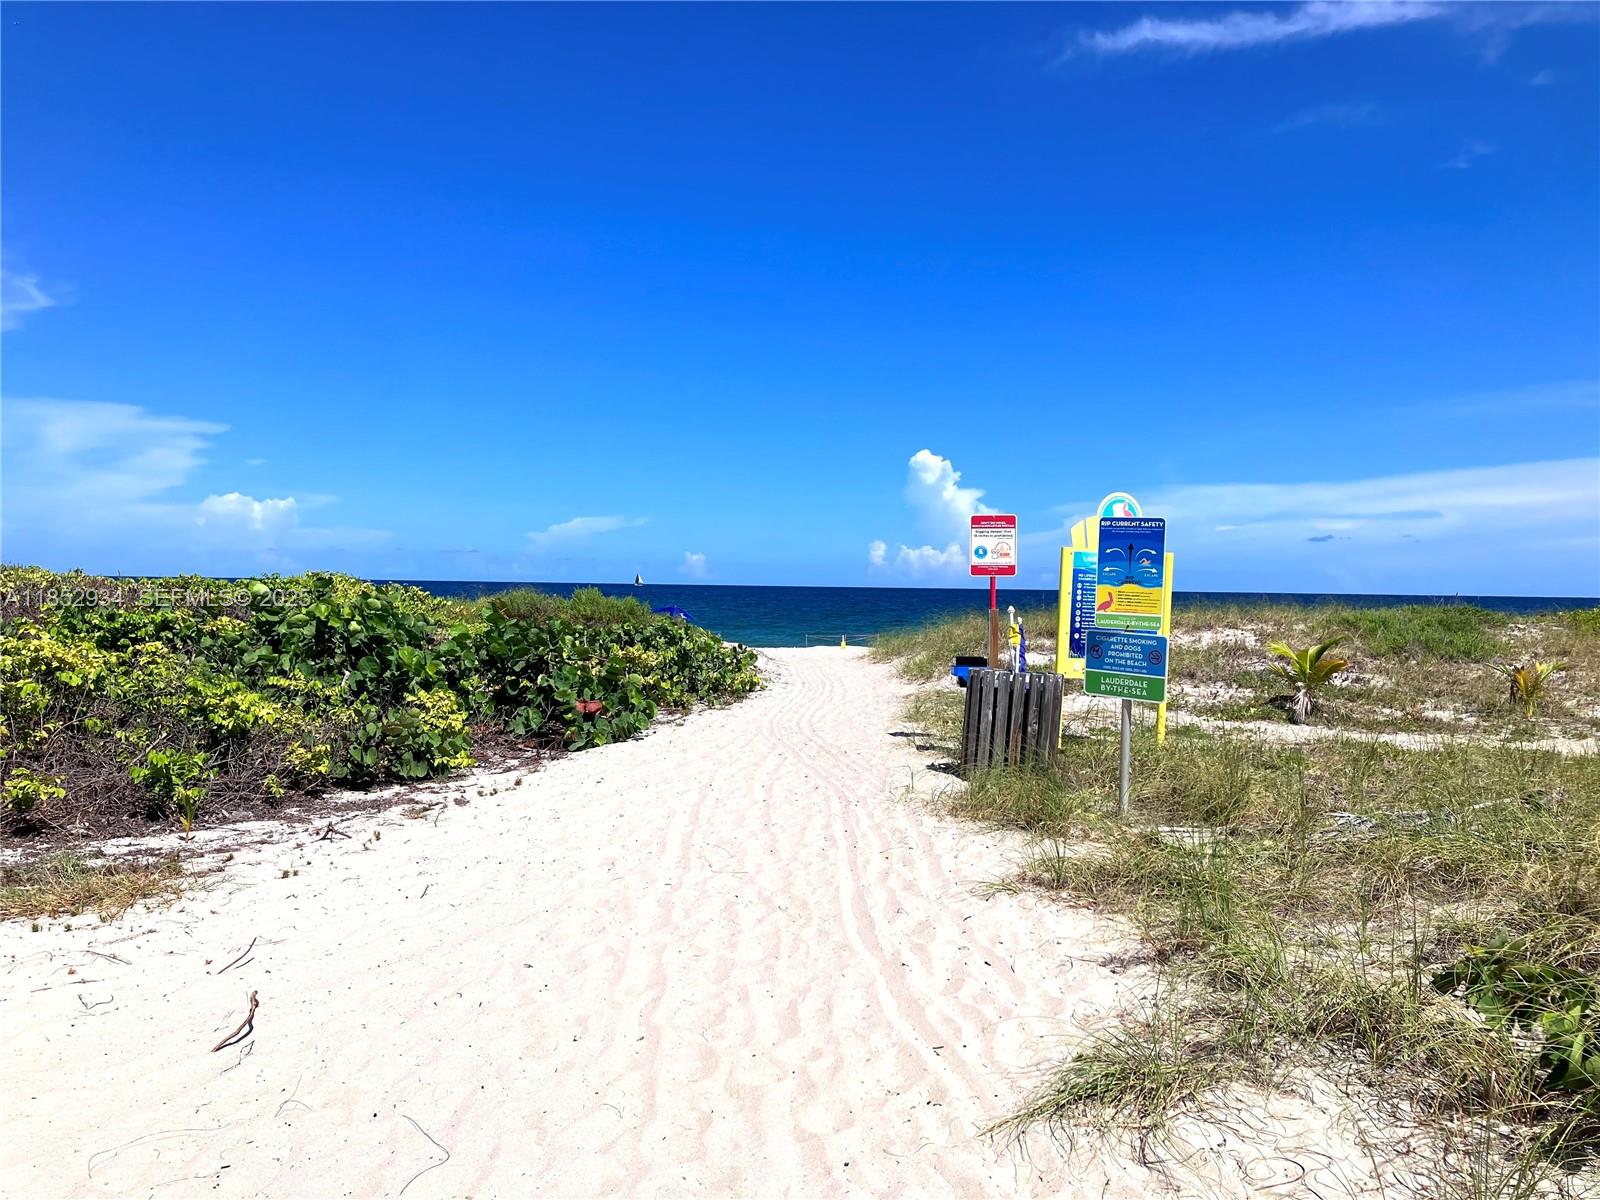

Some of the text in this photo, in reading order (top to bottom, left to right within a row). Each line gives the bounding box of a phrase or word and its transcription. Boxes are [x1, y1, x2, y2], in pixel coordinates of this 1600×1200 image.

[1095, 635, 1157, 646] CIGARETTE SMOKING
[1107, 650, 1143, 660] PROHIBITED
[1100, 676, 1148, 688] LAUDERDALE
